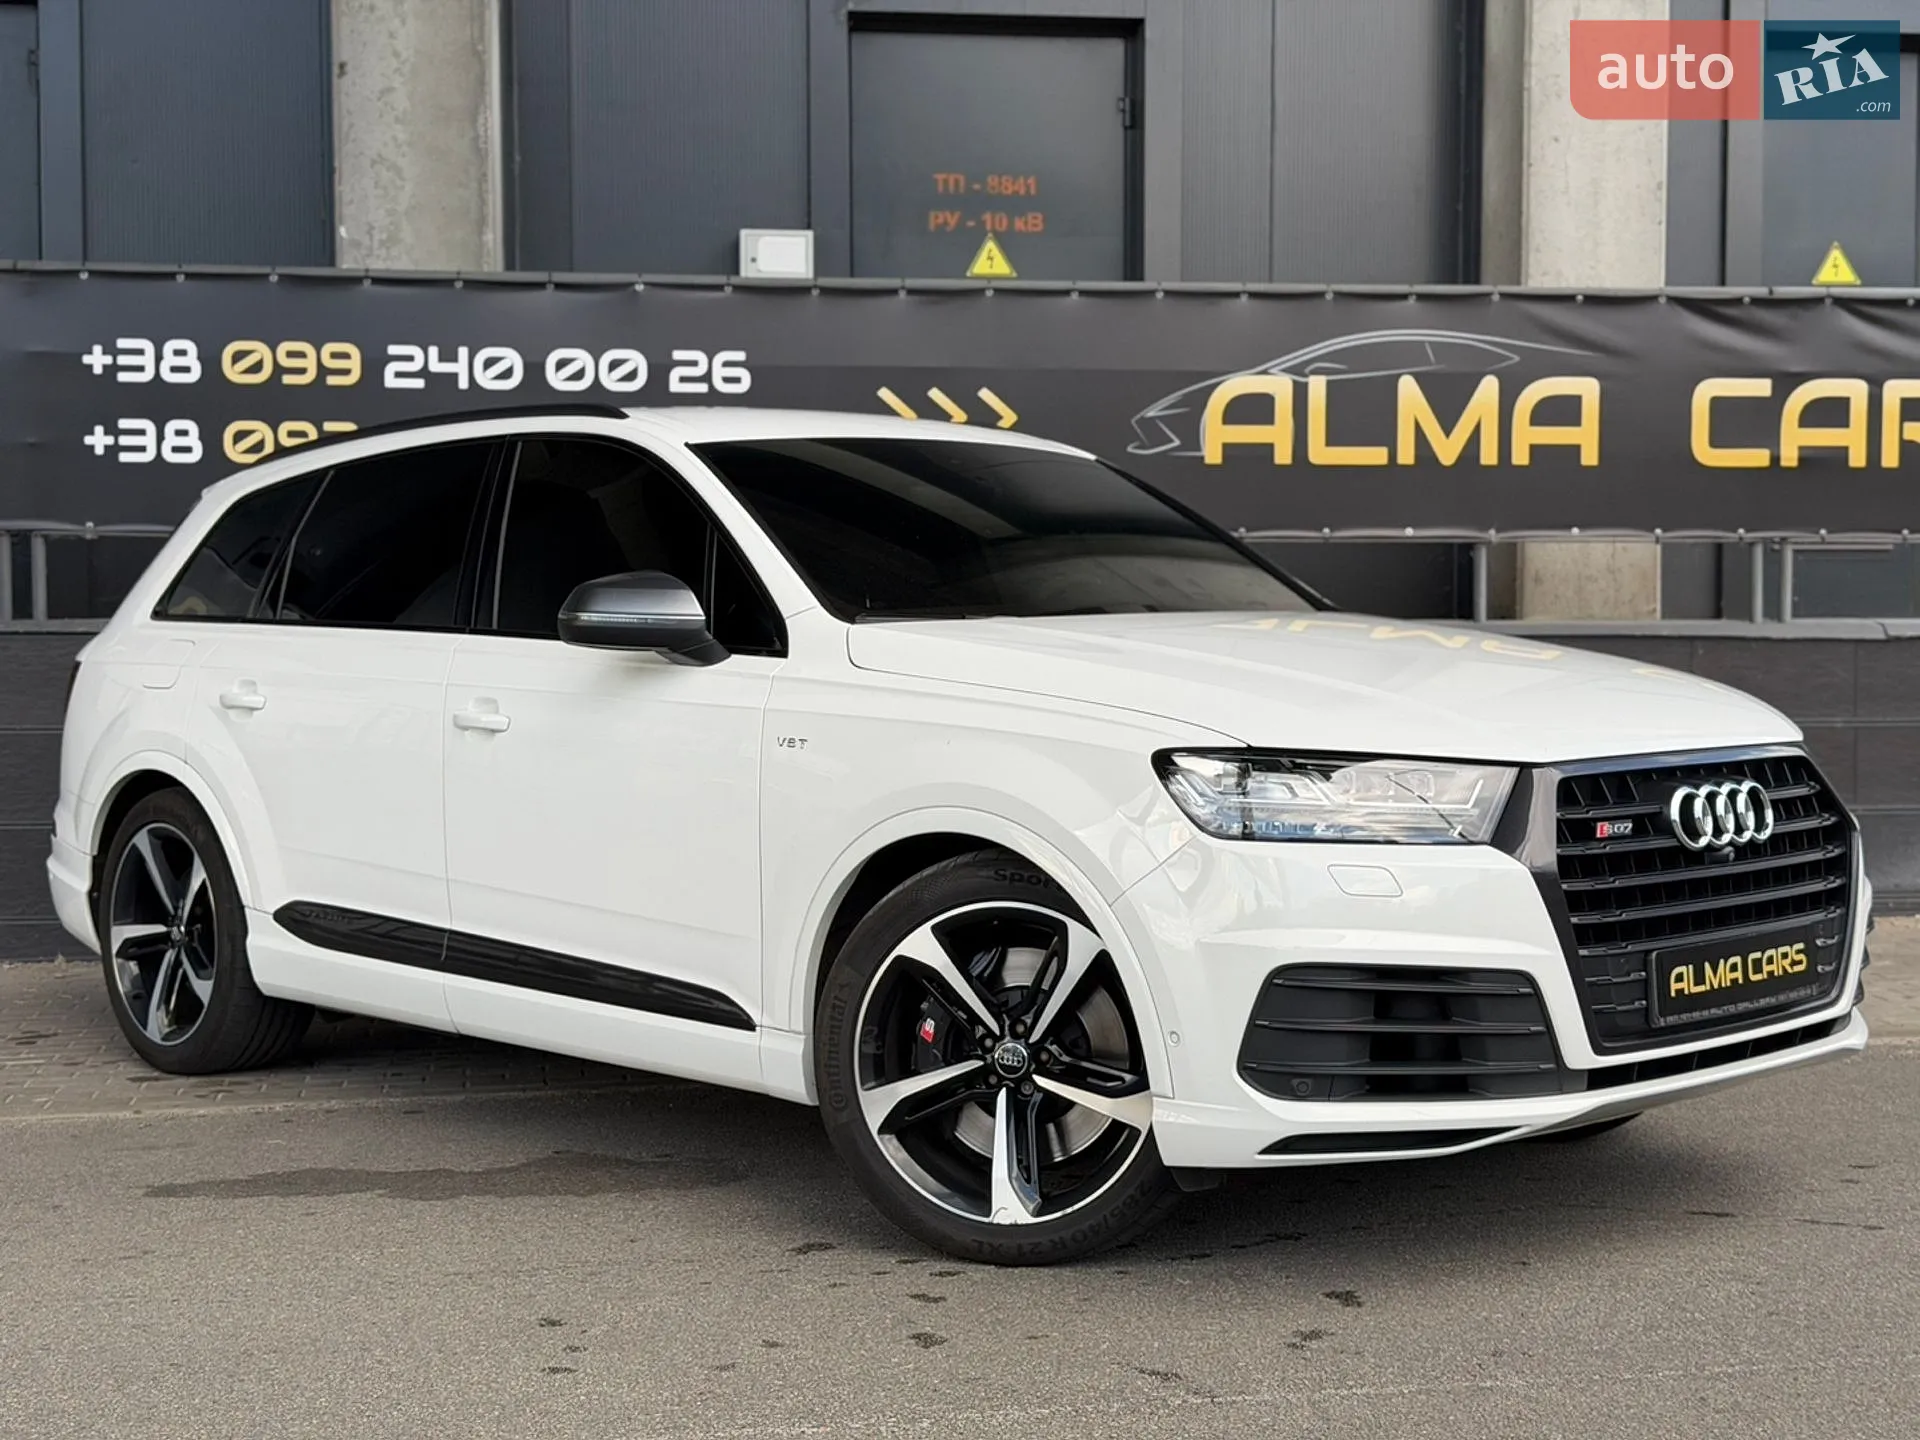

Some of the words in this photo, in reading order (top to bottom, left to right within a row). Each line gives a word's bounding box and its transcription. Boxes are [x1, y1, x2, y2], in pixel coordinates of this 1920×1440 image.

[982, 213, 1008, 231] 10
[82, 338, 201, 383] +38
[222, 340, 361, 385] 099
[384, 345, 523, 390] 240
[545, 348, 647, 392] 00
[669, 350, 751, 393] 26
[84, 419, 203, 463] +38
[223, 420, 358, 463] 09
[1203, 374, 1600, 466] ALMA
[1669, 956, 1743, 997] ALMA
[1748, 942, 1807, 981] CARS
